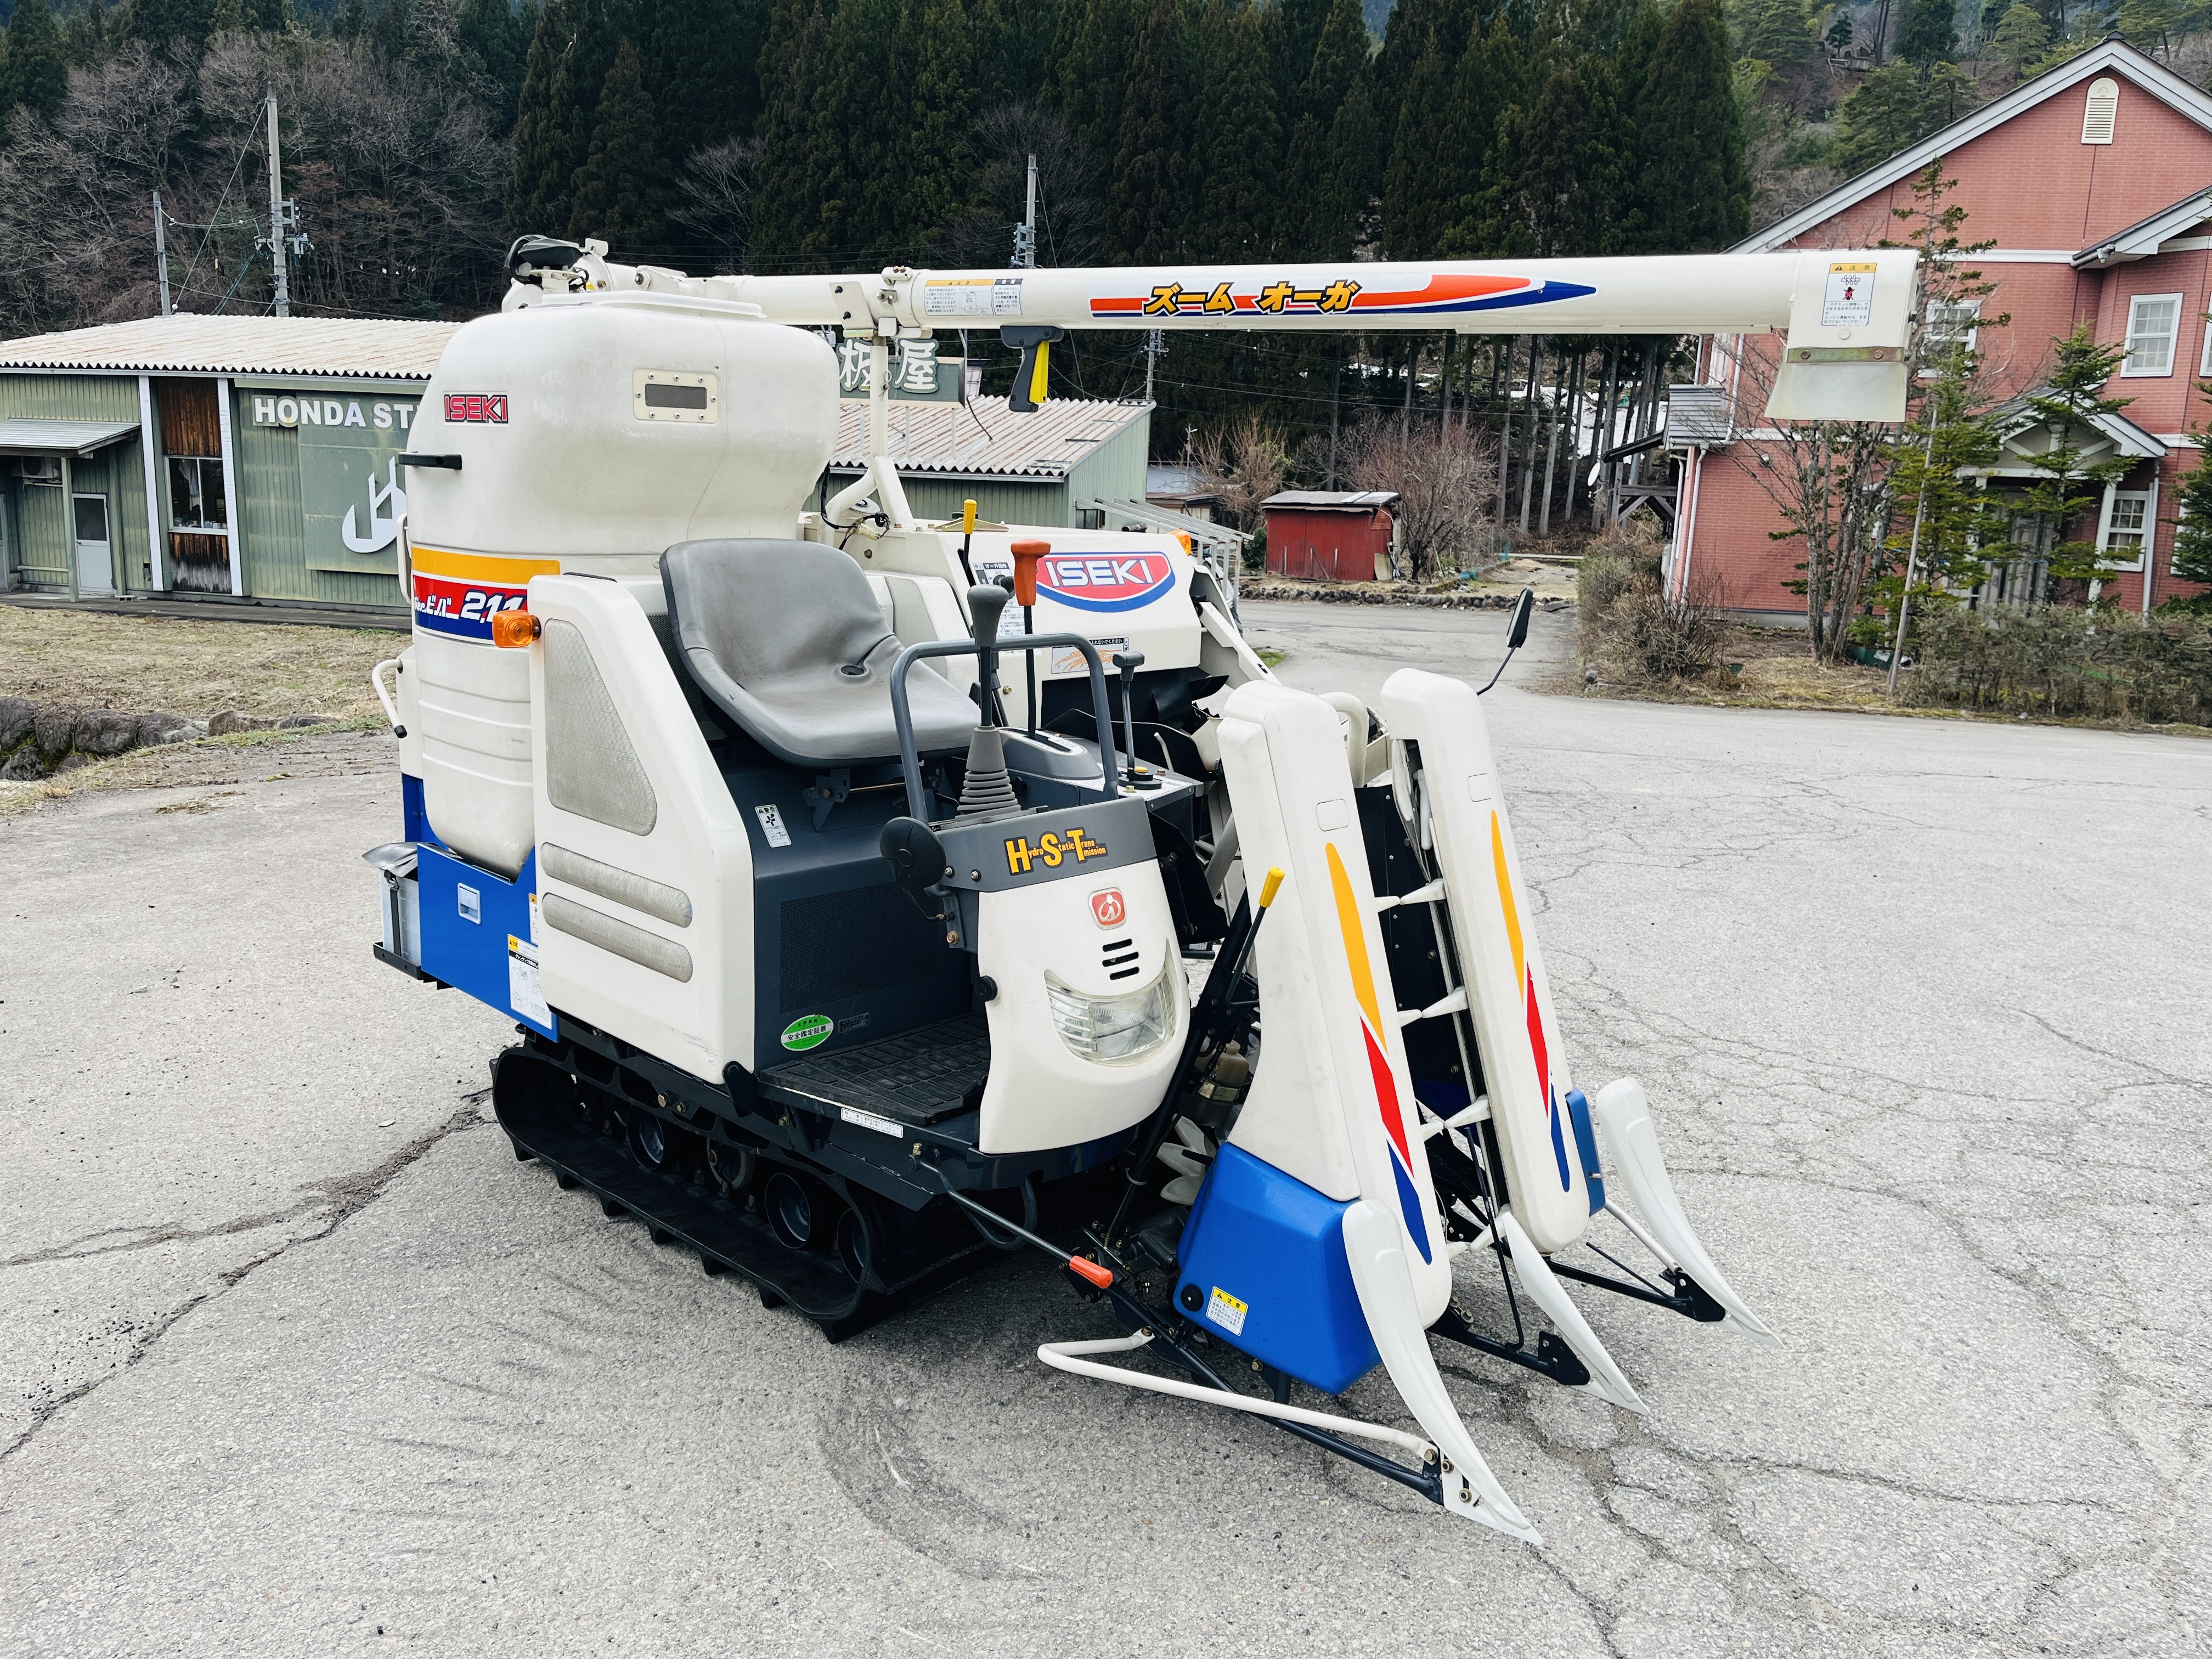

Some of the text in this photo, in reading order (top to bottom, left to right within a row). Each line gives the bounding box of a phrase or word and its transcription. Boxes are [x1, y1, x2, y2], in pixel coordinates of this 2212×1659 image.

[1144, 280, 1362, 314] ズーム オーガ
[254, 398, 420, 429] HONDA ST
[444, 394, 509, 424] ISEKI
[1045, 558, 1155, 588] ISEKI
[787, 1025, 827, 1041] 安全鑑定証票
